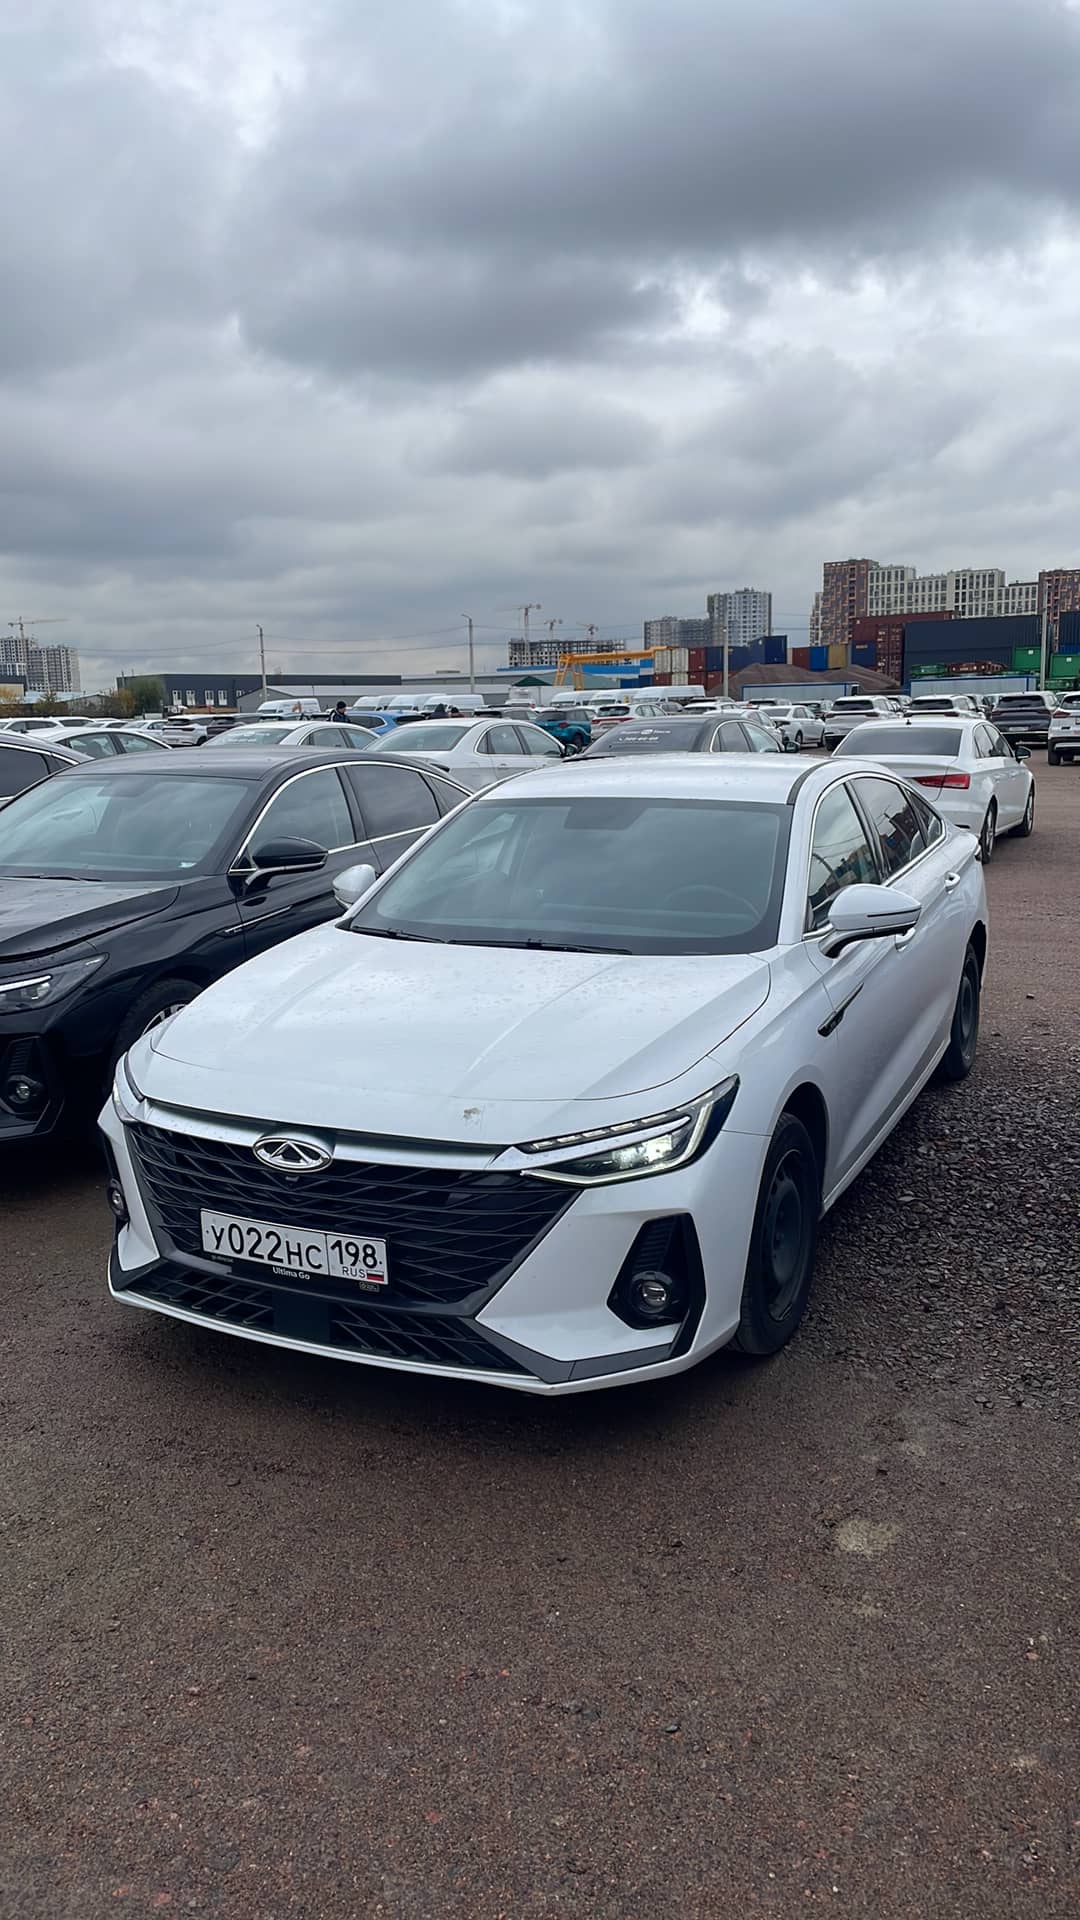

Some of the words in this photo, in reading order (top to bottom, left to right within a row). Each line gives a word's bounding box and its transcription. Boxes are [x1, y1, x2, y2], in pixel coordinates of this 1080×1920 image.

[330, 1240, 377, 1268] 198
[273, 1266, 298, 1278] Ultima
[298, 1272, 311, 1280] Go
[342, 1266, 366, 1278] RUS
